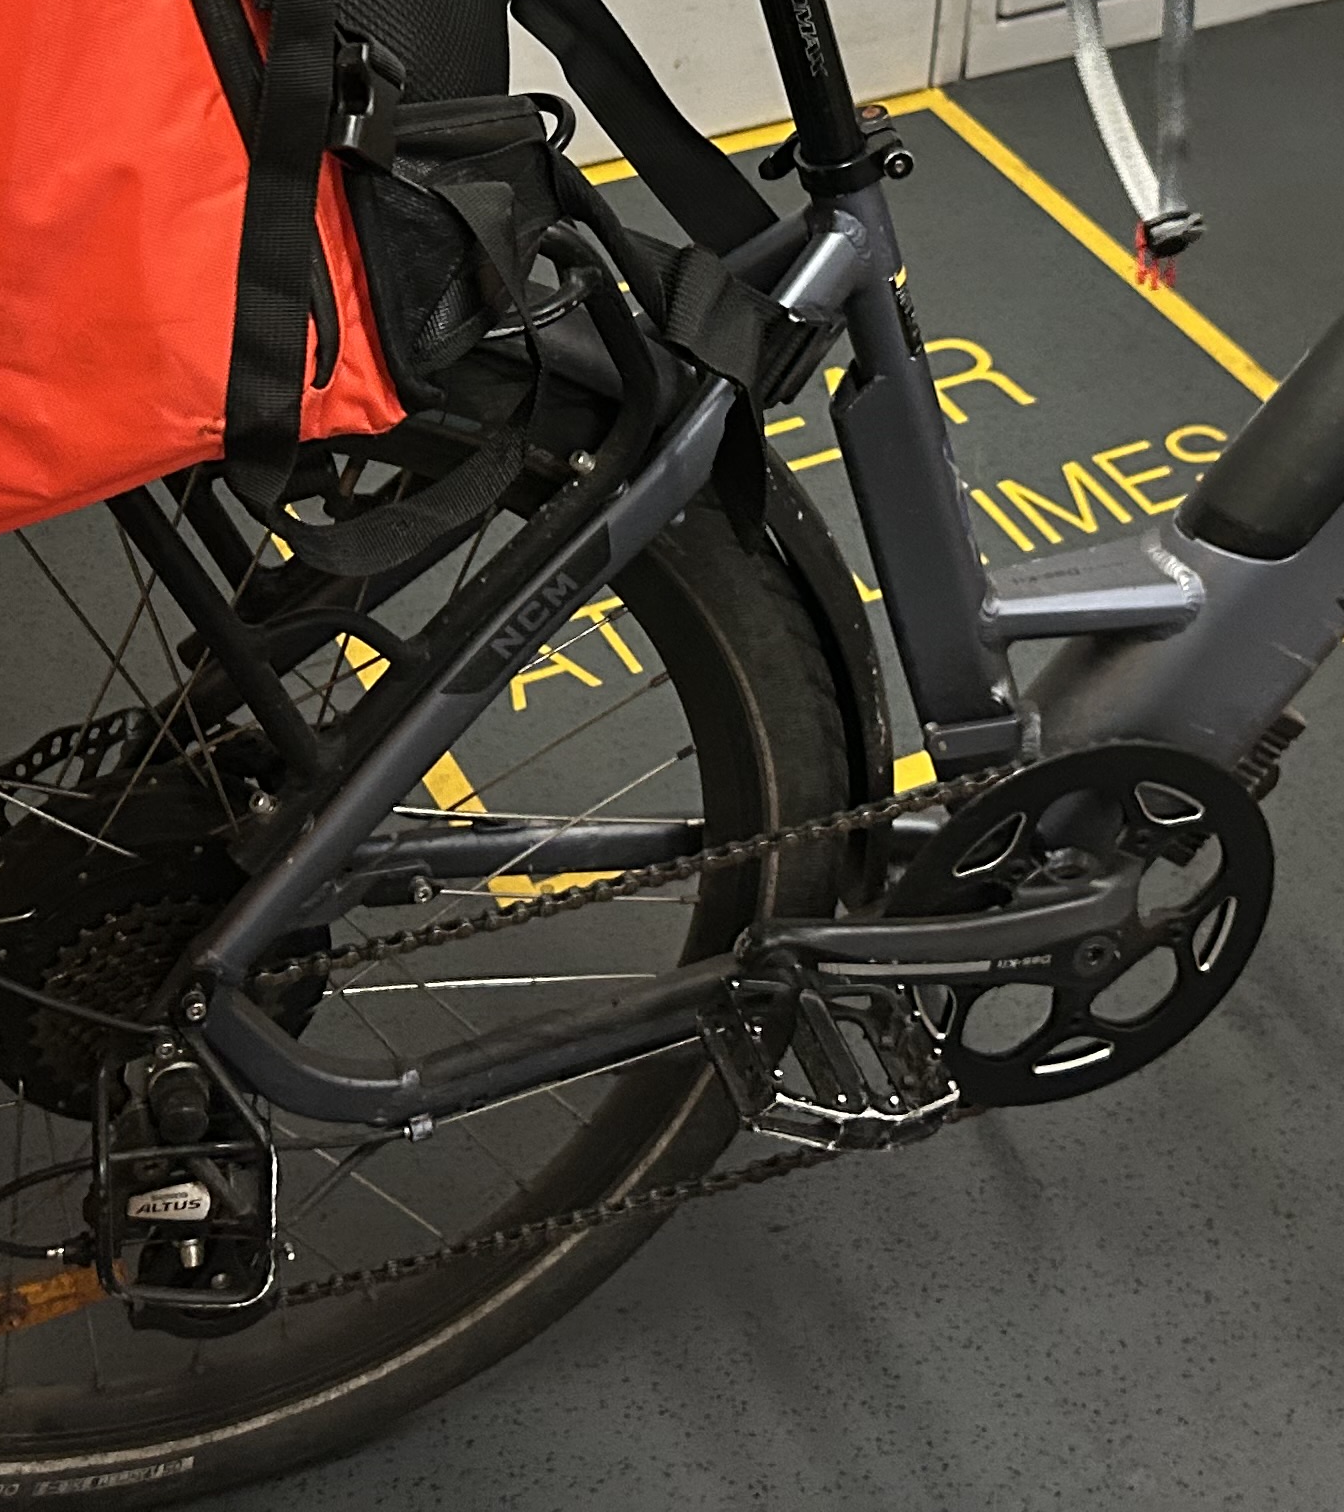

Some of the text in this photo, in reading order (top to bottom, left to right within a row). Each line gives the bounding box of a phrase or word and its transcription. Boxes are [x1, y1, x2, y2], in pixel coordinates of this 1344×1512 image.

[971, 424, 1229, 553] IMES
[490, 571, 579, 660] NCM
[135, 1198, 203, 1215] ALTUS
